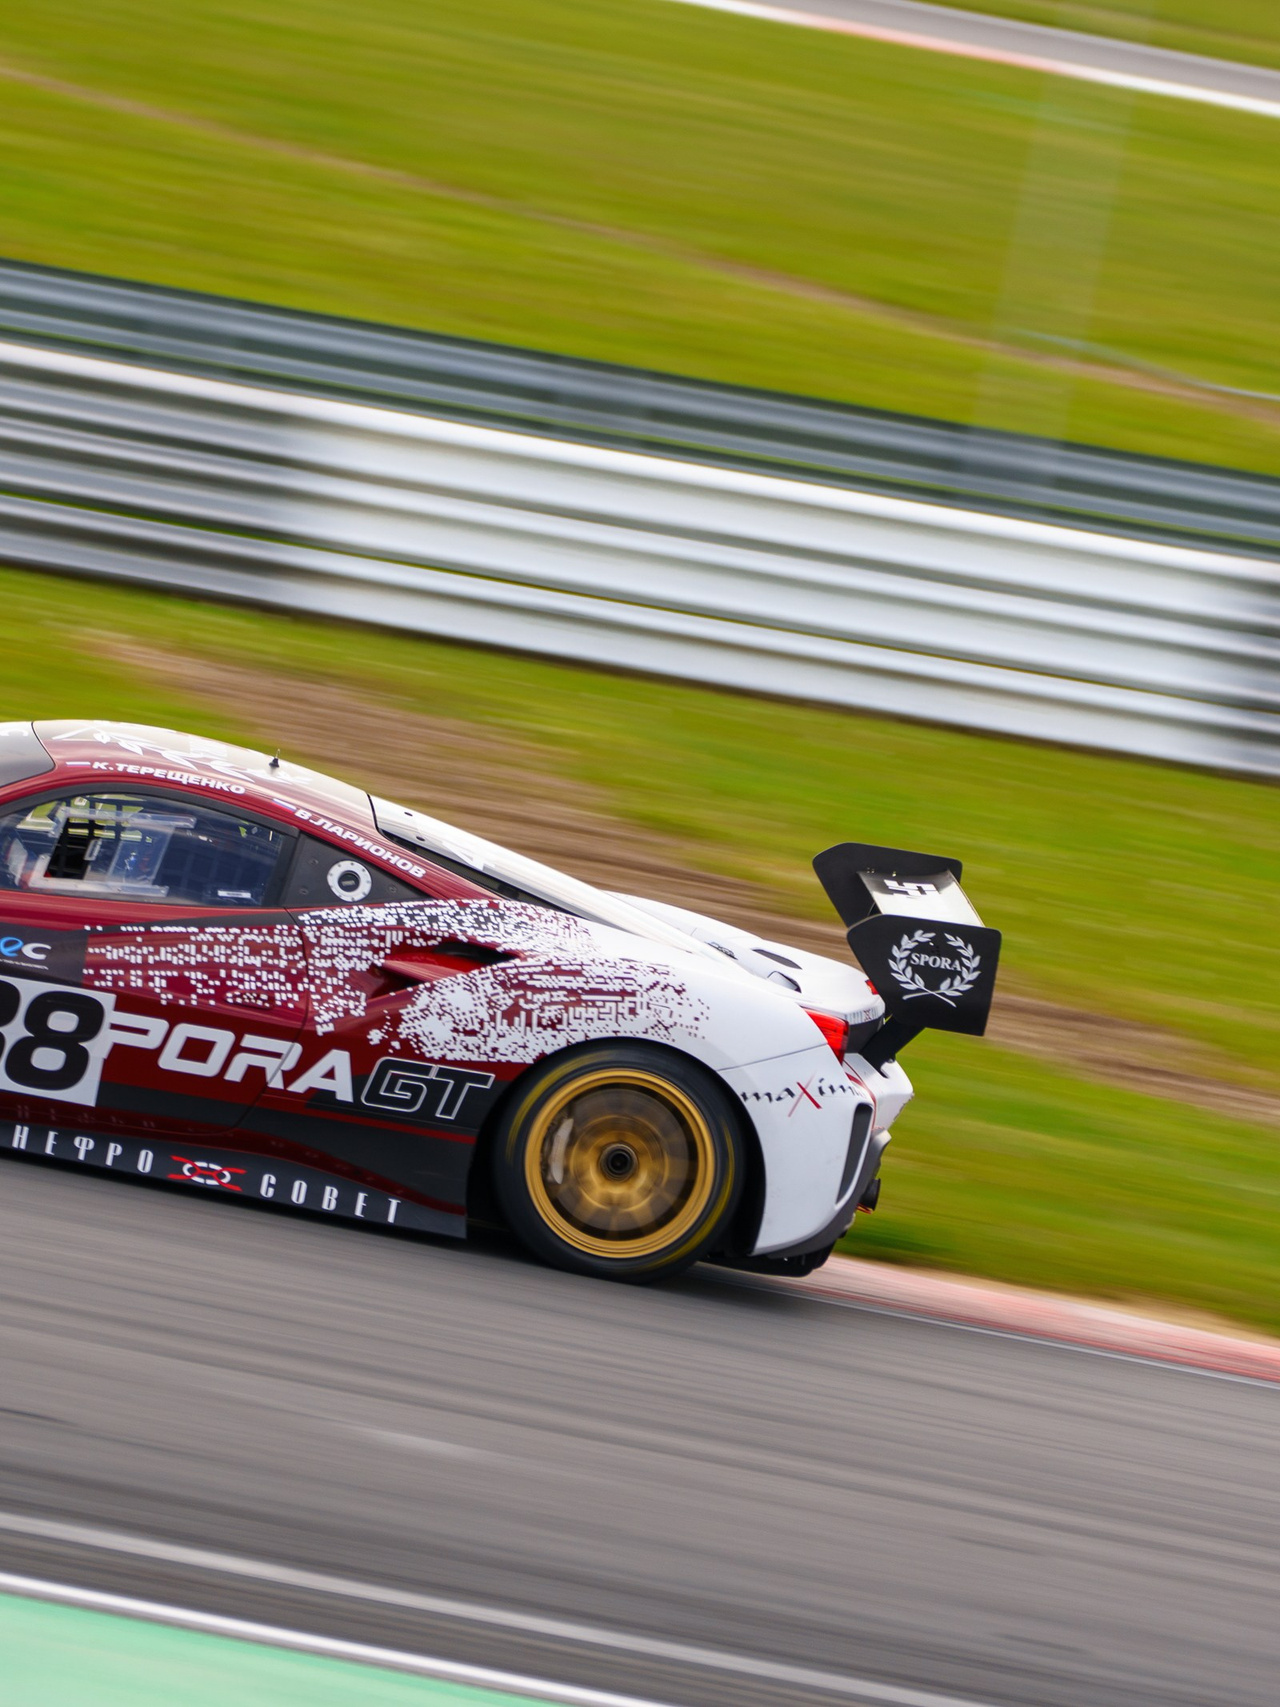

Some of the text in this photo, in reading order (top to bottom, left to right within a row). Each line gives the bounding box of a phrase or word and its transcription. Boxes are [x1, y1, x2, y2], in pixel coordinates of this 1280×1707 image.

[93, 761, 246, 795] К.ТЕРЕЩЕНКО
[910, 953, 963, 972] SPORA
[360, 1056, 496, 1120] GT
[12, 1124, 402, 1224] НЕФРО СОВЕТ
